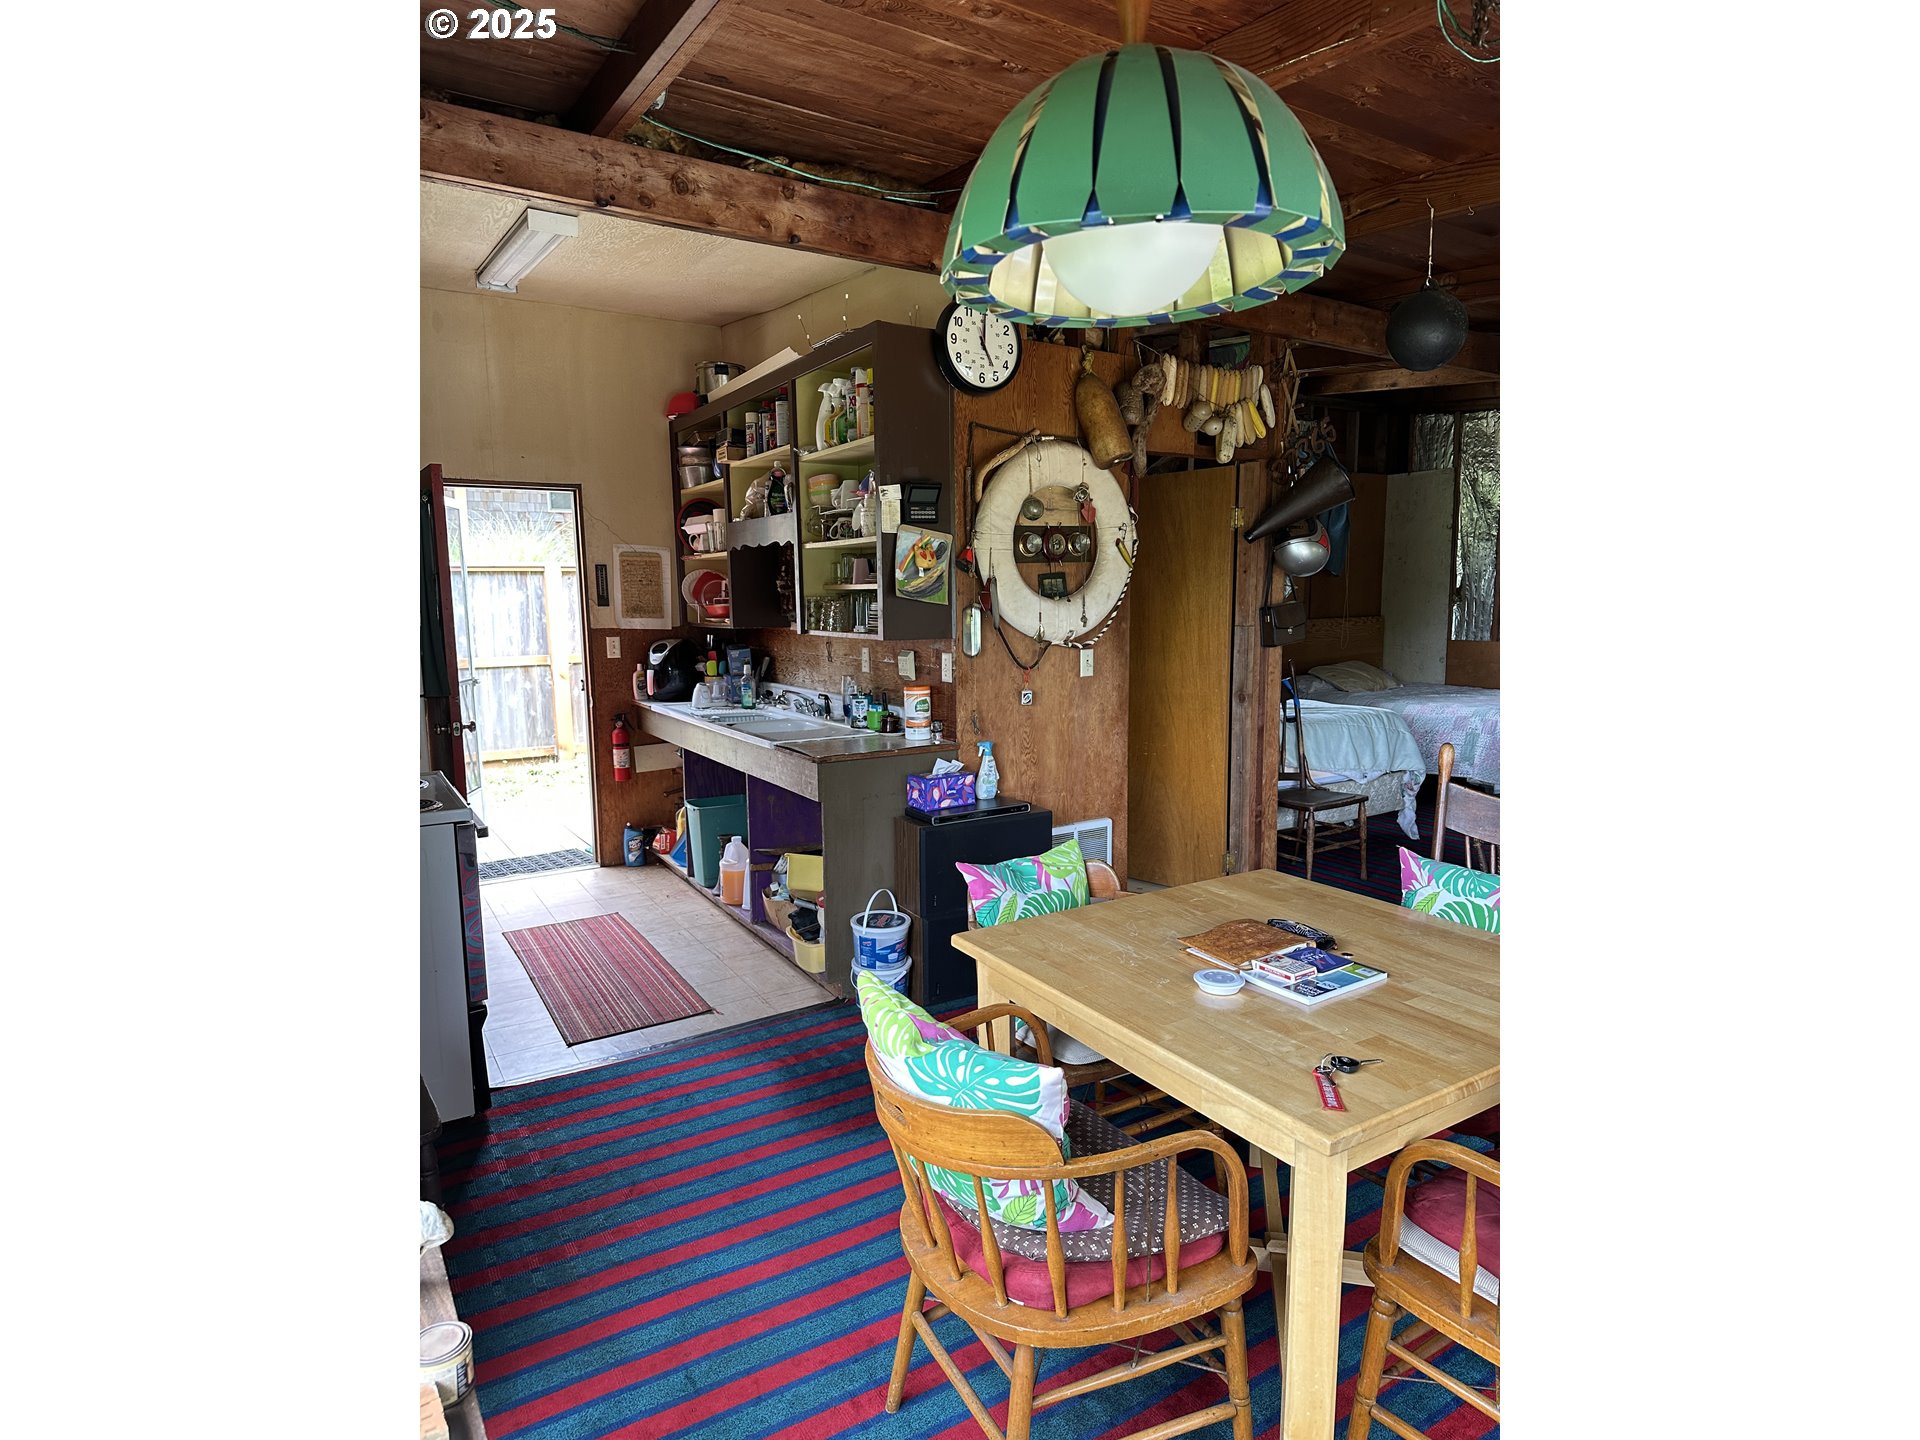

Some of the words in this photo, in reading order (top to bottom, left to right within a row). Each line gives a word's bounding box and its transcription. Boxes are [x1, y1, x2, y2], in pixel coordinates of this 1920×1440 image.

[953, 316, 963, 327] 10
[1003, 325, 1010, 336] 2
[950, 332, 957, 344] 9
[1007, 343, 1014, 355] 3
[955, 352, 962, 363] 8
[1002, 360, 1010, 372] 4
[979, 372, 986, 384] 6
[992, 371, 999, 382] 5
